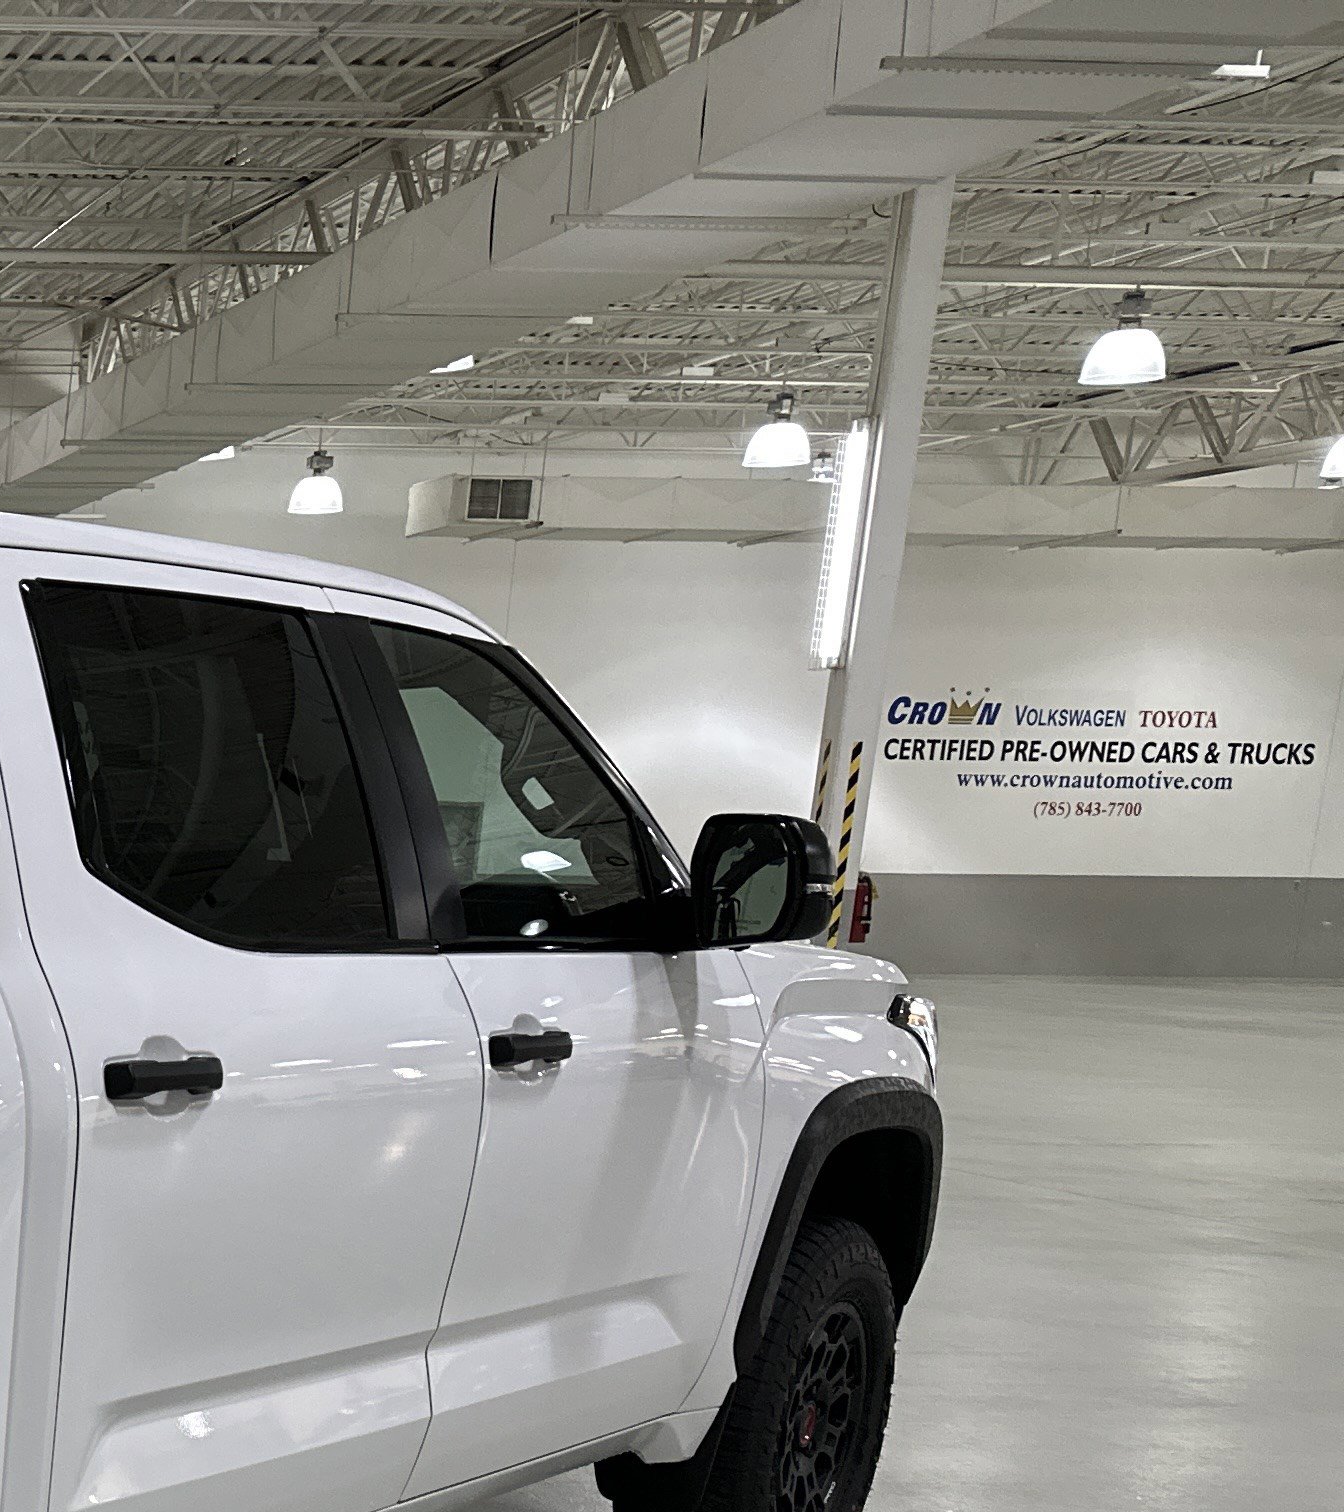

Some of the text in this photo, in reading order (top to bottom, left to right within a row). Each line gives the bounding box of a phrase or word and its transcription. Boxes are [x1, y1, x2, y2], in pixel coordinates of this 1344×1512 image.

[887, 687, 1219, 729] CROWN VOLKSWAGEN TOYOTA
[883, 738, 1316, 766] CERTIFIED PRE-OWNED CARS & TRUCKS
[956, 770, 1234, 791] www.crownautomotive.com
[1032, 801, 1143, 819] (785) 843-7700
